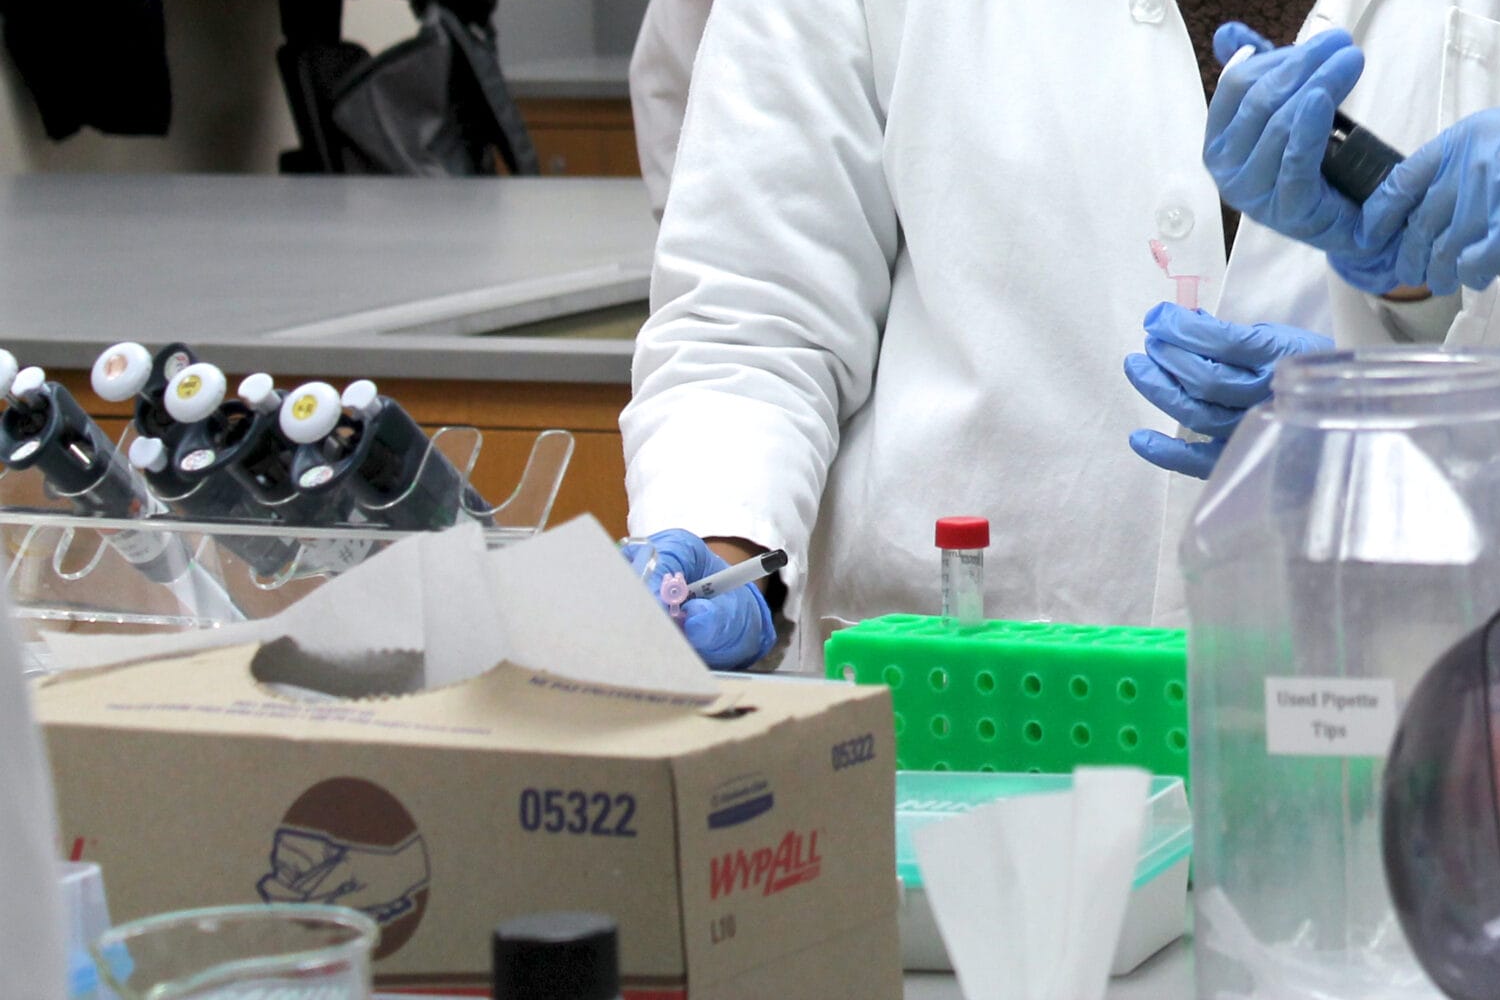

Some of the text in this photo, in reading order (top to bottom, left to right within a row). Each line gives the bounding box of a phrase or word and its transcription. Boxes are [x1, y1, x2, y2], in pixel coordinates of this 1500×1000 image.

[1276, 690, 1379, 711] Used Pipette
[1311, 719, 1348, 741] Tips
[831, 732, 876, 771] 05322
[519, 787, 638, 838] 05322
